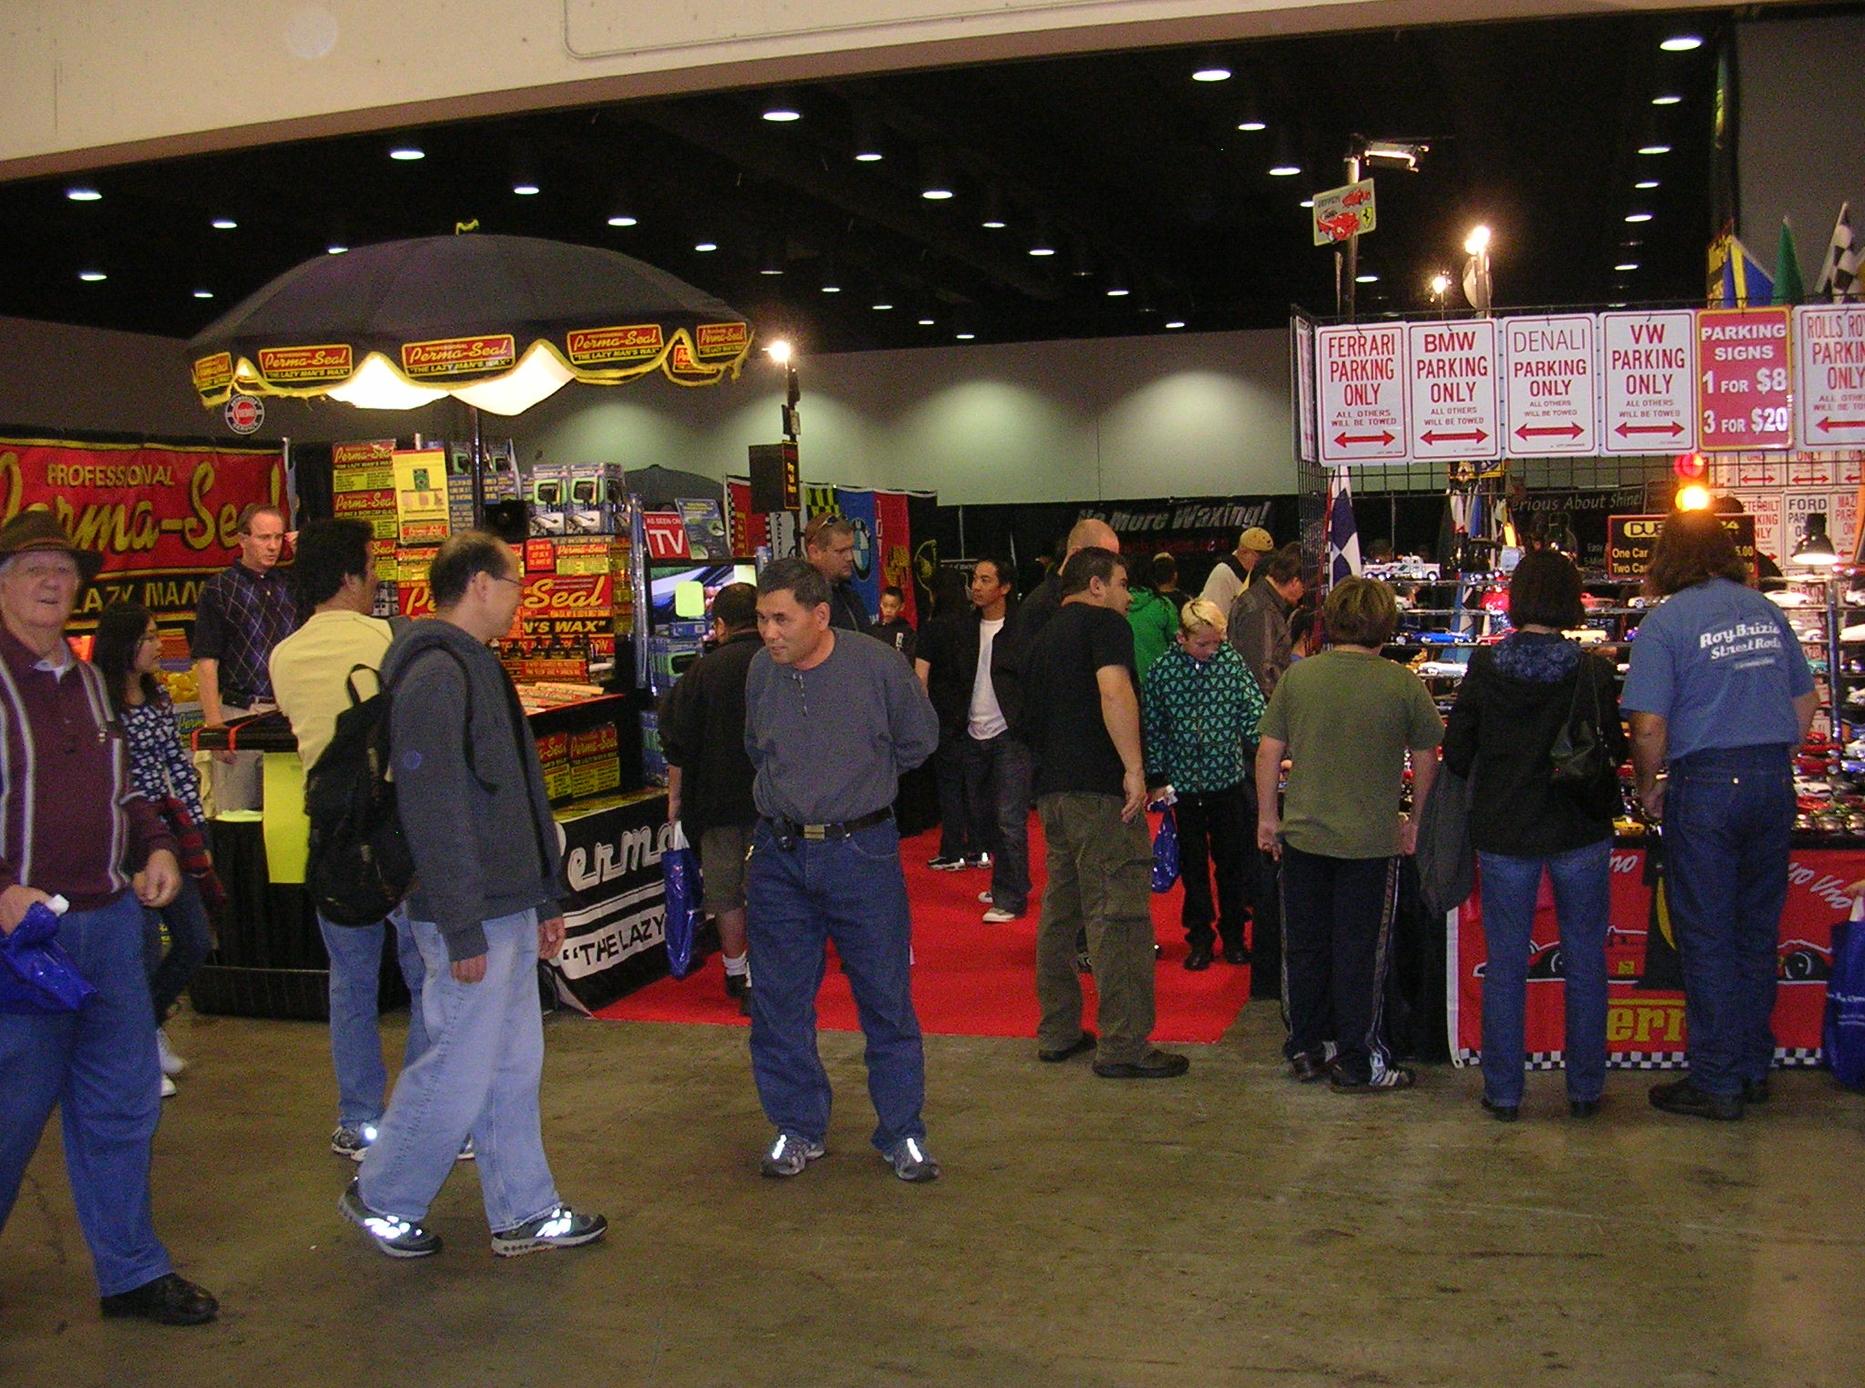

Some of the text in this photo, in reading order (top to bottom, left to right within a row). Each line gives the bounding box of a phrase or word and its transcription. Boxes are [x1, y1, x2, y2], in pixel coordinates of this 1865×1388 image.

[1630, 323, 1665, 345] VW
[1701, 324, 1786, 341] PARKING
[1808, 315, 1842, 338] ROLLS
[574, 329, 657, 351] Perma-Seal
[1328, 333, 1395, 358] FERRARI
[1424, 332, 1476, 353] BMW
[1514, 328, 1585, 352] DENALI
[265, 349, 347, 368] Perma-Seal
[410, 340, 508, 364] Perma-Seal
[1612, 348, 1685, 370] PARKING
[1714, 345, 1774, 361] SIGNS
[1812, 341, 1865, 365] PARKIN
[1330, 358, 1394, 382] PARKING
[1417, 356, 1488, 379] PARKING
[1514, 359, 1587, 377] PARKING
[1530, 379, 1572, 397] ONLY
[1626, 373, 1673, 395] ONLY
[1702, 367, 1787, 394] 1 FOR $8
[1344, 383, 1381, 406] ONLY
[1431, 382, 1476, 403] ONLY
[1642, 399, 1674, 407] OTHERS
[1331, 418, 1397, 427] WILL BE TOWED
[1357, 410, 1391, 418] OTHERS
[1424, 418, 1442, 426] WILL
[1457, 417, 1484, 425] TOWED
[1703, 407, 1787, 434] 3 FOR $20
[47, 464, 175, 487] PROFESSIONAL
[1511, 496, 1559, 511] erious
[1564, 494, 1605, 510] About
[1743, 501, 1780, 512] ETERBILT
[1788, 499, 1828, 511] FORD
[1172, 501, 1272, 530] Waxing!
[649, 529, 683, 554] TV
[1755, 528, 1772, 539] NLY
[1612, 548, 1630, 558] One
[1632, 547, 1648, 558] Car
[1612, 562, 1649, 573] Two Car
[71, 583, 135, 614] AZY
[555, 620, 606, 633] WAX"
[1700, 629, 1735, 649] Roy
[1711, 640, 1754, 660] Street
[619, 911, 666, 952] LAZY
